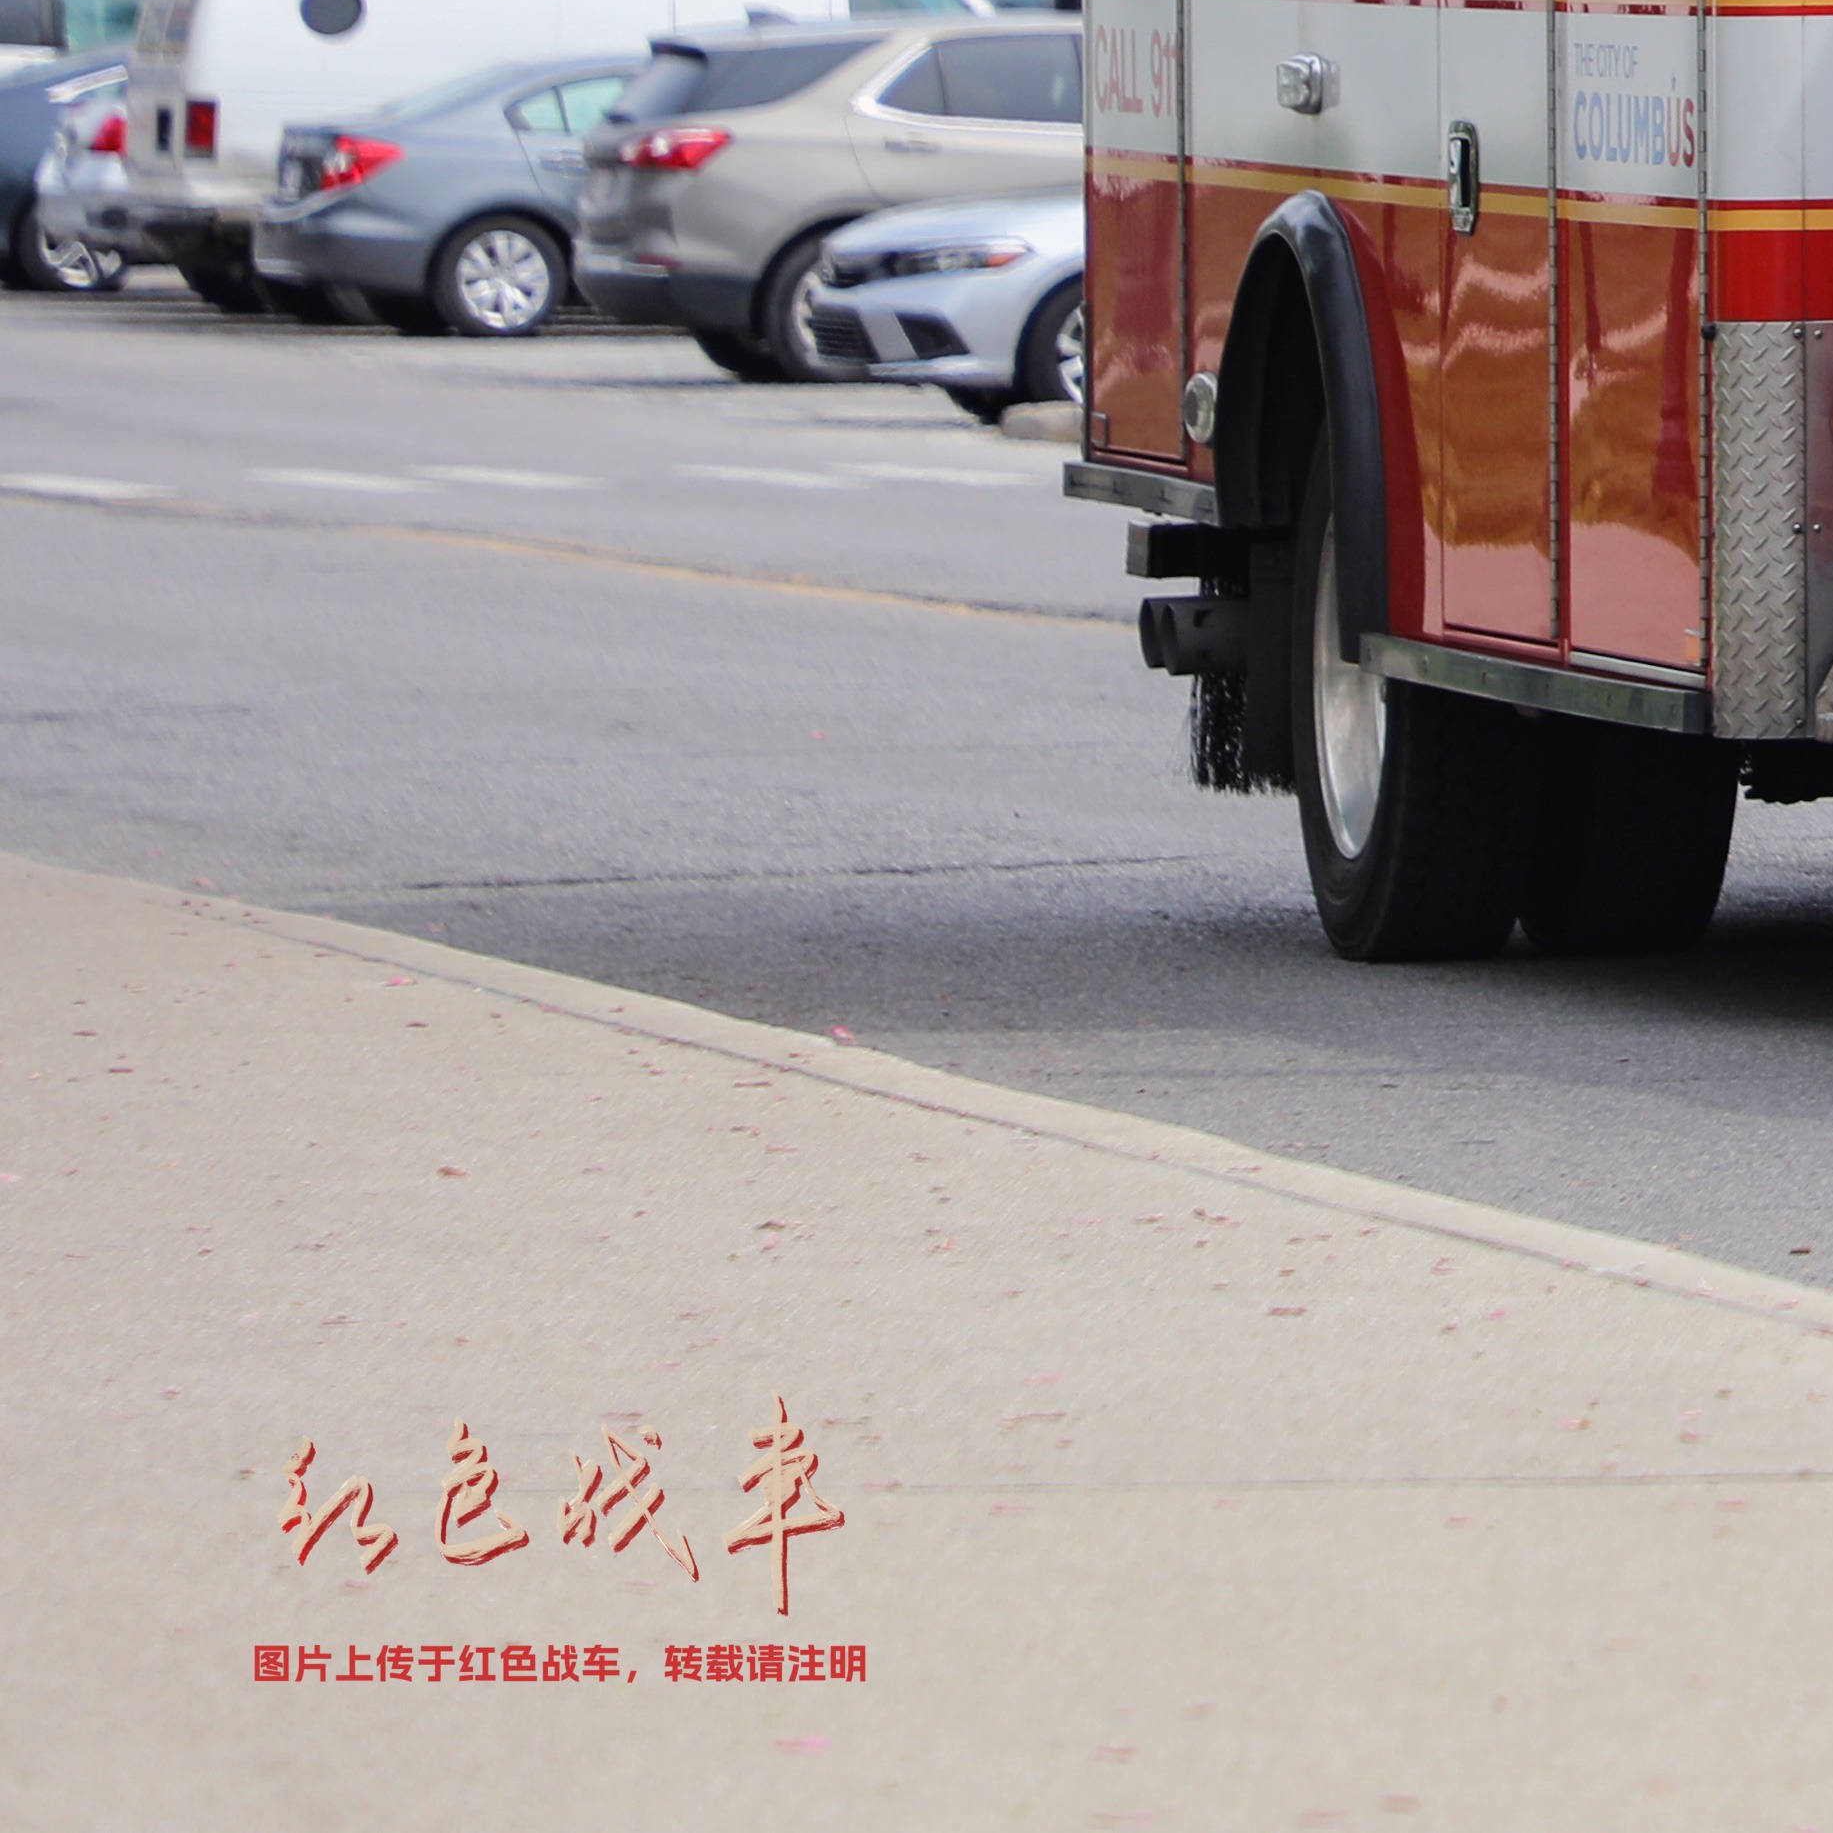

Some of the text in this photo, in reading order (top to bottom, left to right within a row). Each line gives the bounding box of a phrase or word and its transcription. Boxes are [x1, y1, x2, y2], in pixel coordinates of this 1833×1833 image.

[1095, 24, 1145, 115] CALL
[1573, 42, 1638, 80] THE CITY OF
[1573, 89, 1696, 168] COLUMBUS
